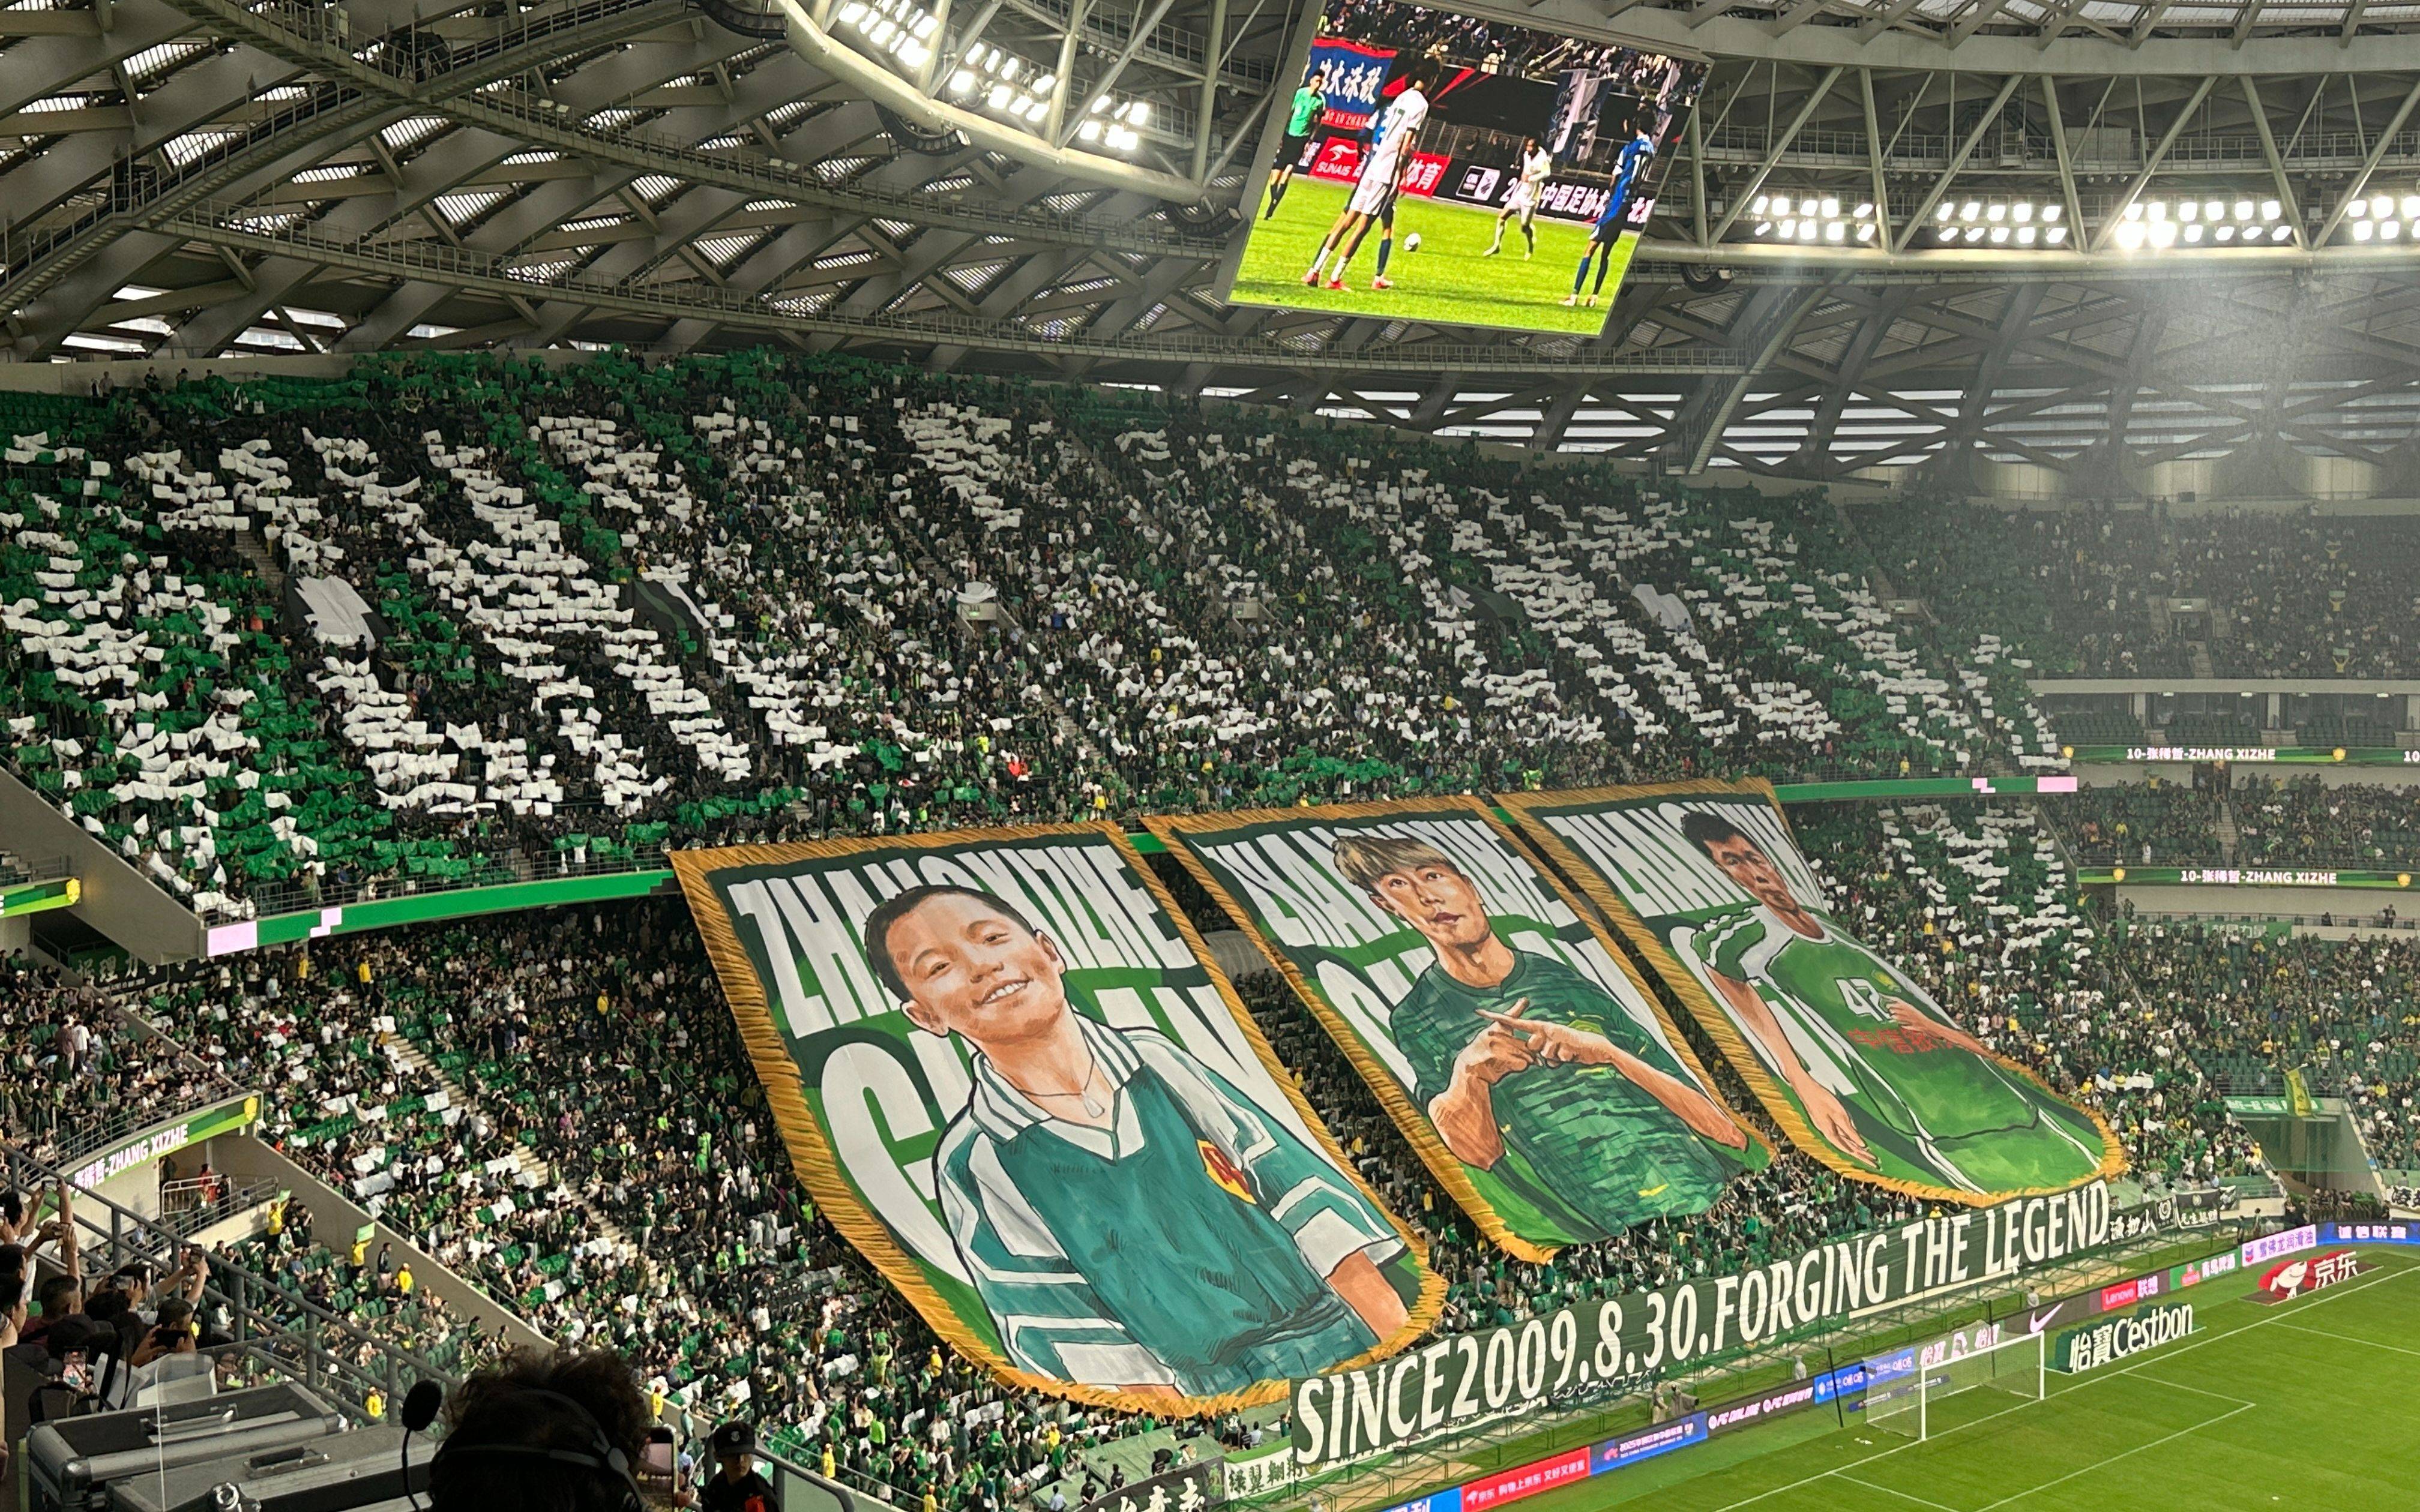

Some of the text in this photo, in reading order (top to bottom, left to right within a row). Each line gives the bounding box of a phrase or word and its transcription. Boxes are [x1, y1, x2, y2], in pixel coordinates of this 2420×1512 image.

[2236, 748, 2276, 760] XIZHE
[2296, 872, 2337, 884] XIZHE
[150, 1123, 188, 1157] XIZHE
[1902, 1213, 1971, 1294] THE
[2314, 1250, 2358, 1289] 京东
[2104, 1286, 2135, 1306] Lenovo
[2113, 1303, 2193, 1358] C'estbon
